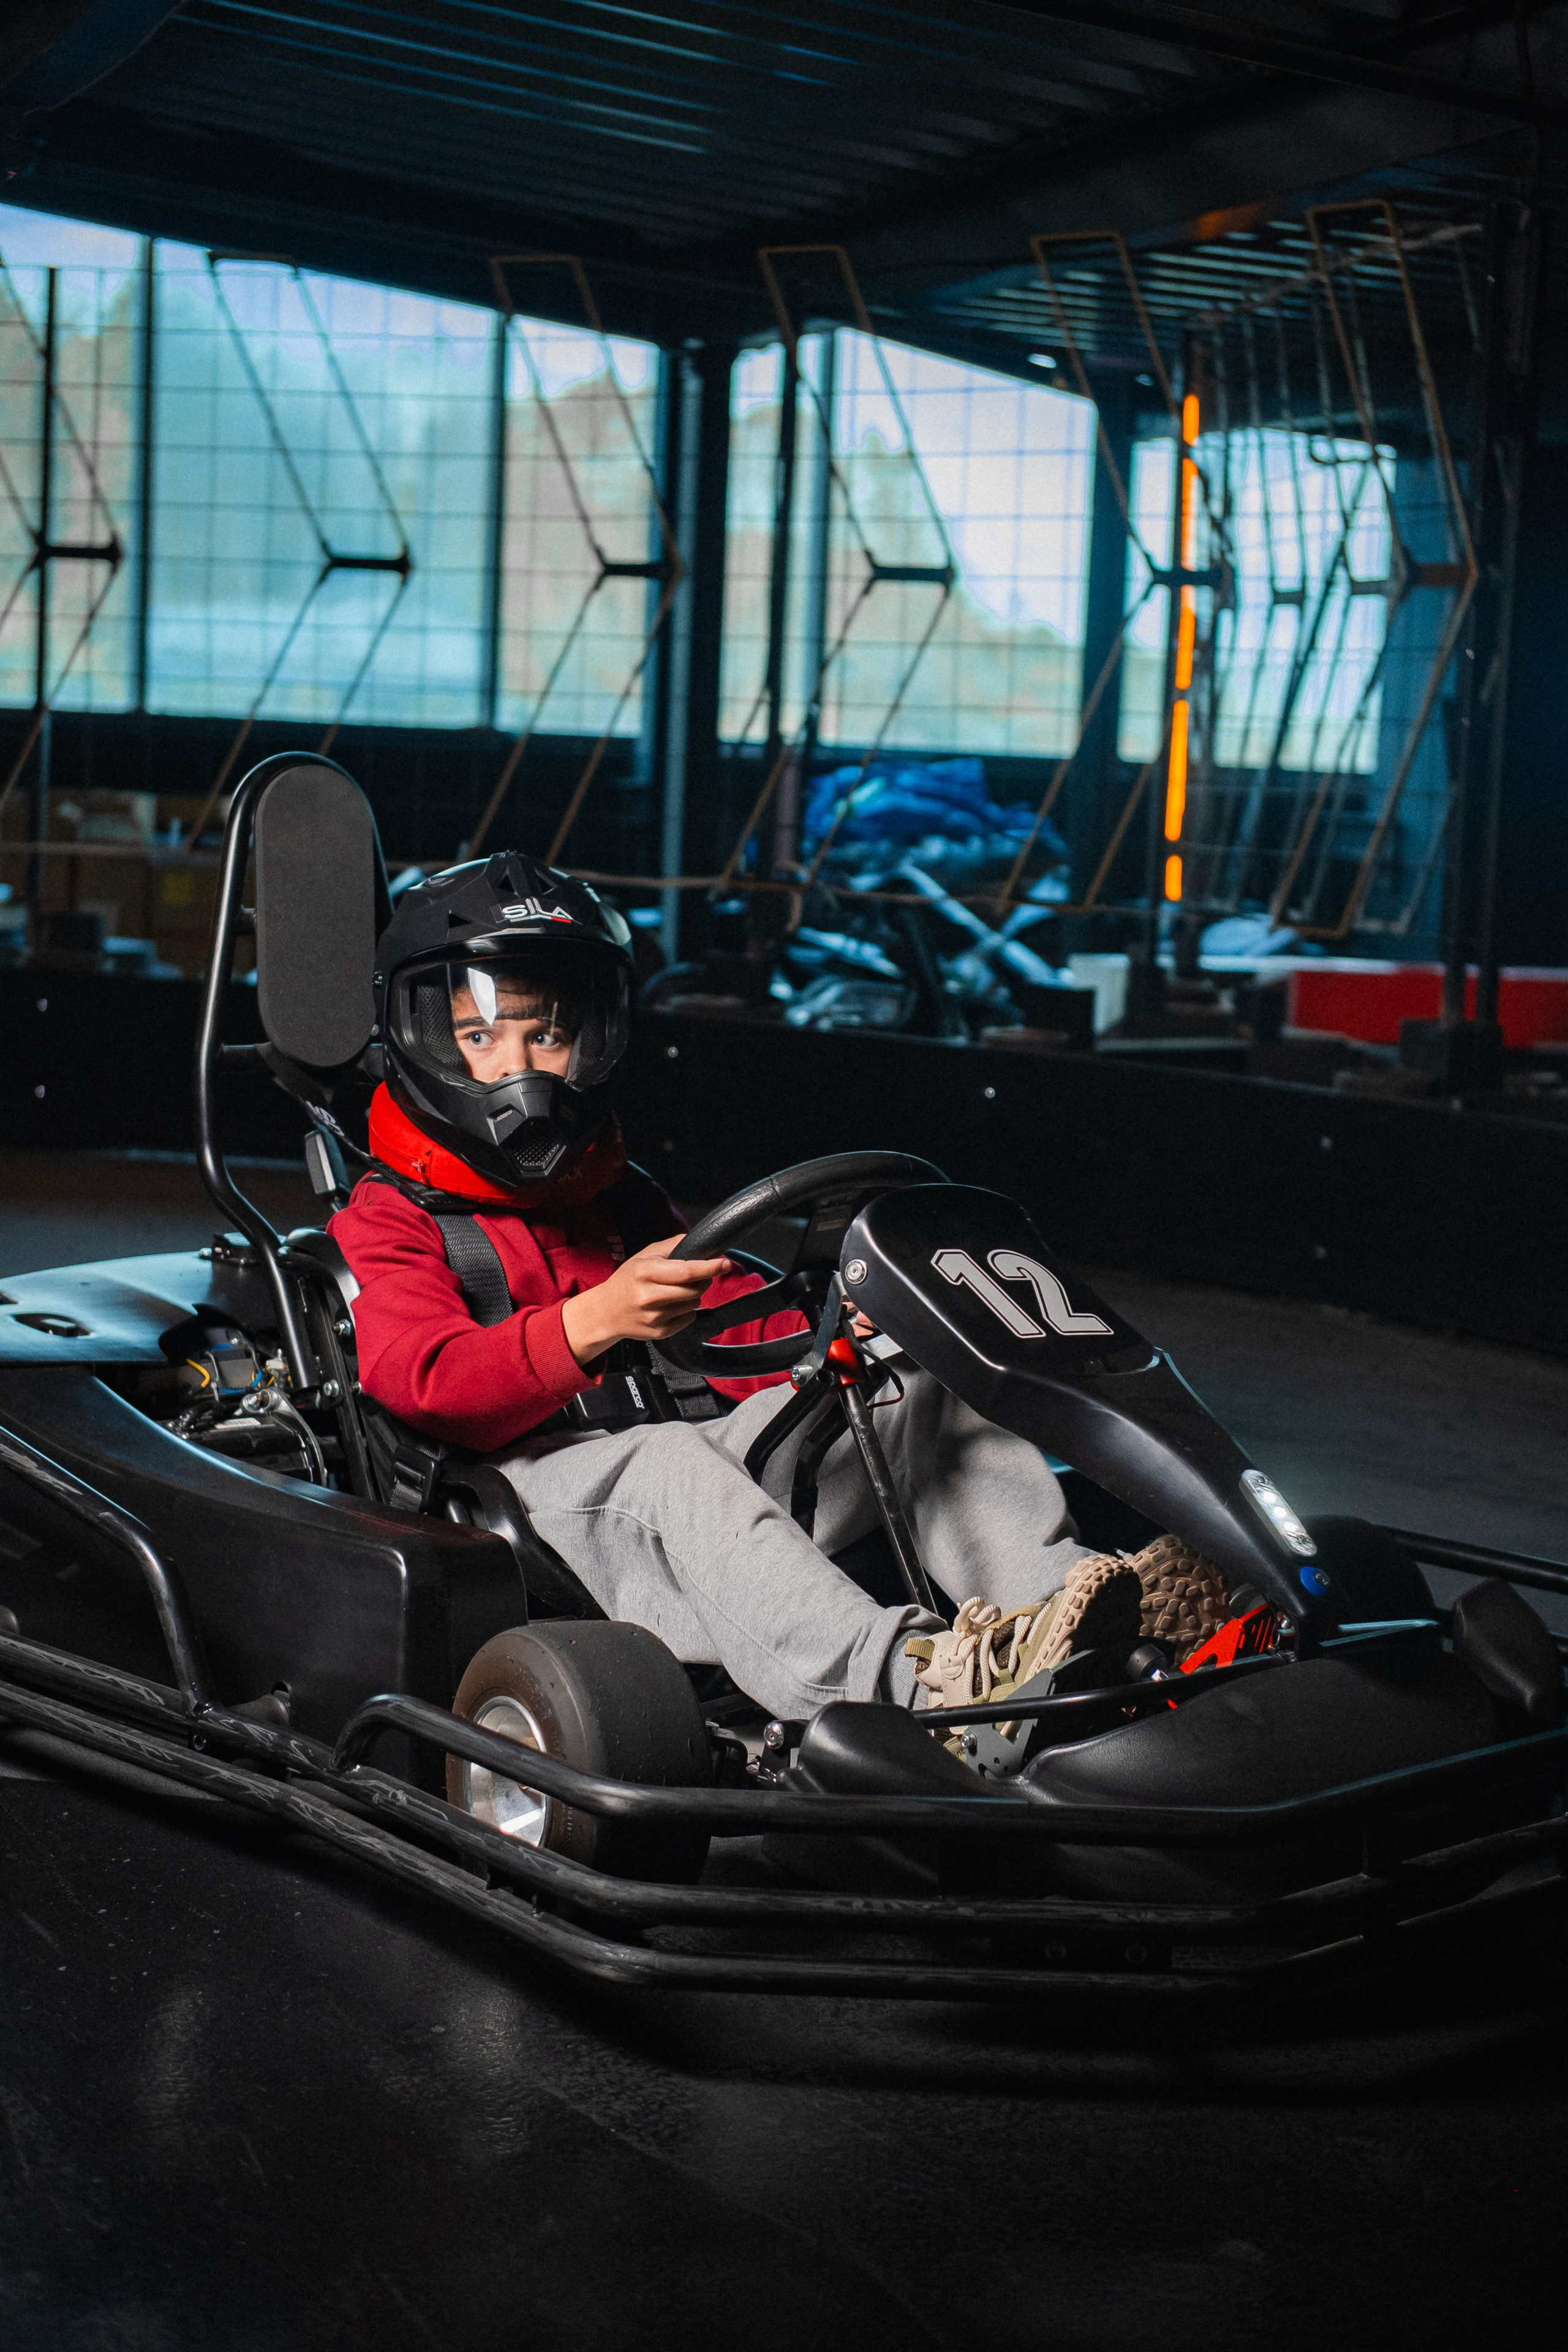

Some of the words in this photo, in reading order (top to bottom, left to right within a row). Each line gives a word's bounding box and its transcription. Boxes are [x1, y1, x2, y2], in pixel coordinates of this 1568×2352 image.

[502, 896, 574, 921] SILA
[930, 1249, 1114, 1338] 12
[627, 1376, 644, 1408] sparco
